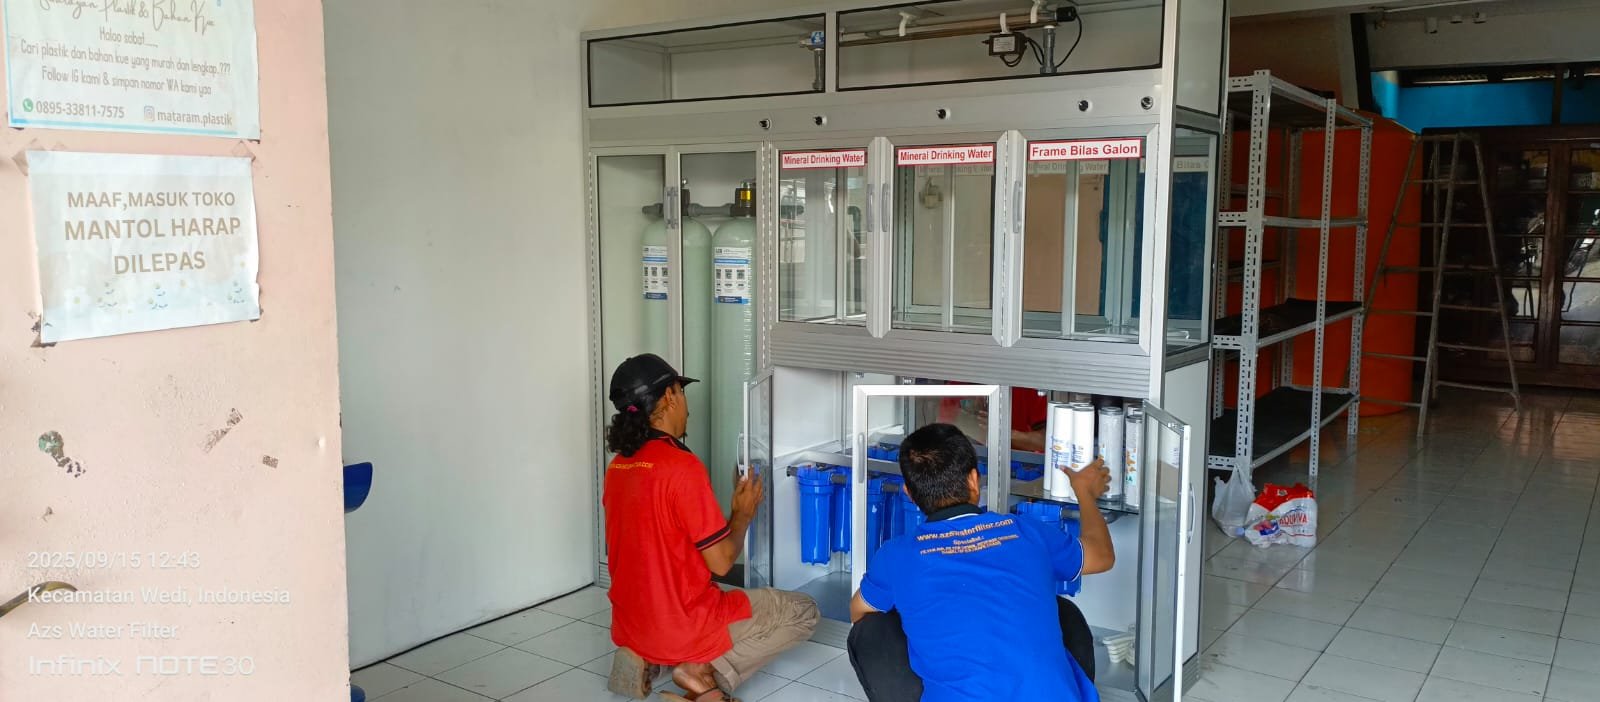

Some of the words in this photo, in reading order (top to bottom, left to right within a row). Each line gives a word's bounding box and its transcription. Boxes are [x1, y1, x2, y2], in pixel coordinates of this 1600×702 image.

[21, 38, 39, 54] Cari
[41, 42, 69, 60] plastik
[71, 45, 87, 59] dan
[88, 47, 113, 61] bahan
[116, 49, 129, 64] kue
[131, 56, 149, 71] yang
[152, 57, 175, 70] murah
[177, 58, 190, 72] dan
[42, 65, 69, 81] Follow
[72, 68, 79, 82] IG
[81, 69, 100, 85] kami
[103, 72, 110, 85] &
[112, 75, 140, 91] simpan
[141, 80, 165, 90] nomor
[166, 78, 180, 92] WA
[181, 79, 197, 94] kami
[36, 100, 125, 118] 0895-33811-7575
[157, 111, 233, 127] mataram.plastik
[784, 155, 809, 165] Mineral
[810, 154, 841, 164] Drinking
[842, 153, 864, 162] Water
[900, 151, 929, 161] Mineral
[931, 150, 965, 161] Drinking
[967, 149, 992, 159] Water
[1032, 147, 1067, 157] Frame
[1070, 145, 1099, 156] Bilas
[1102, 144, 1138, 155] Galon
[67, 191, 189, 211] MAAF,MASUK
[191, 190, 236, 207] TOKO
[64, 218, 165, 241] MANTOL
[171, 216, 241, 237] HARAP
[114, 251, 206, 274] DILEPAS
